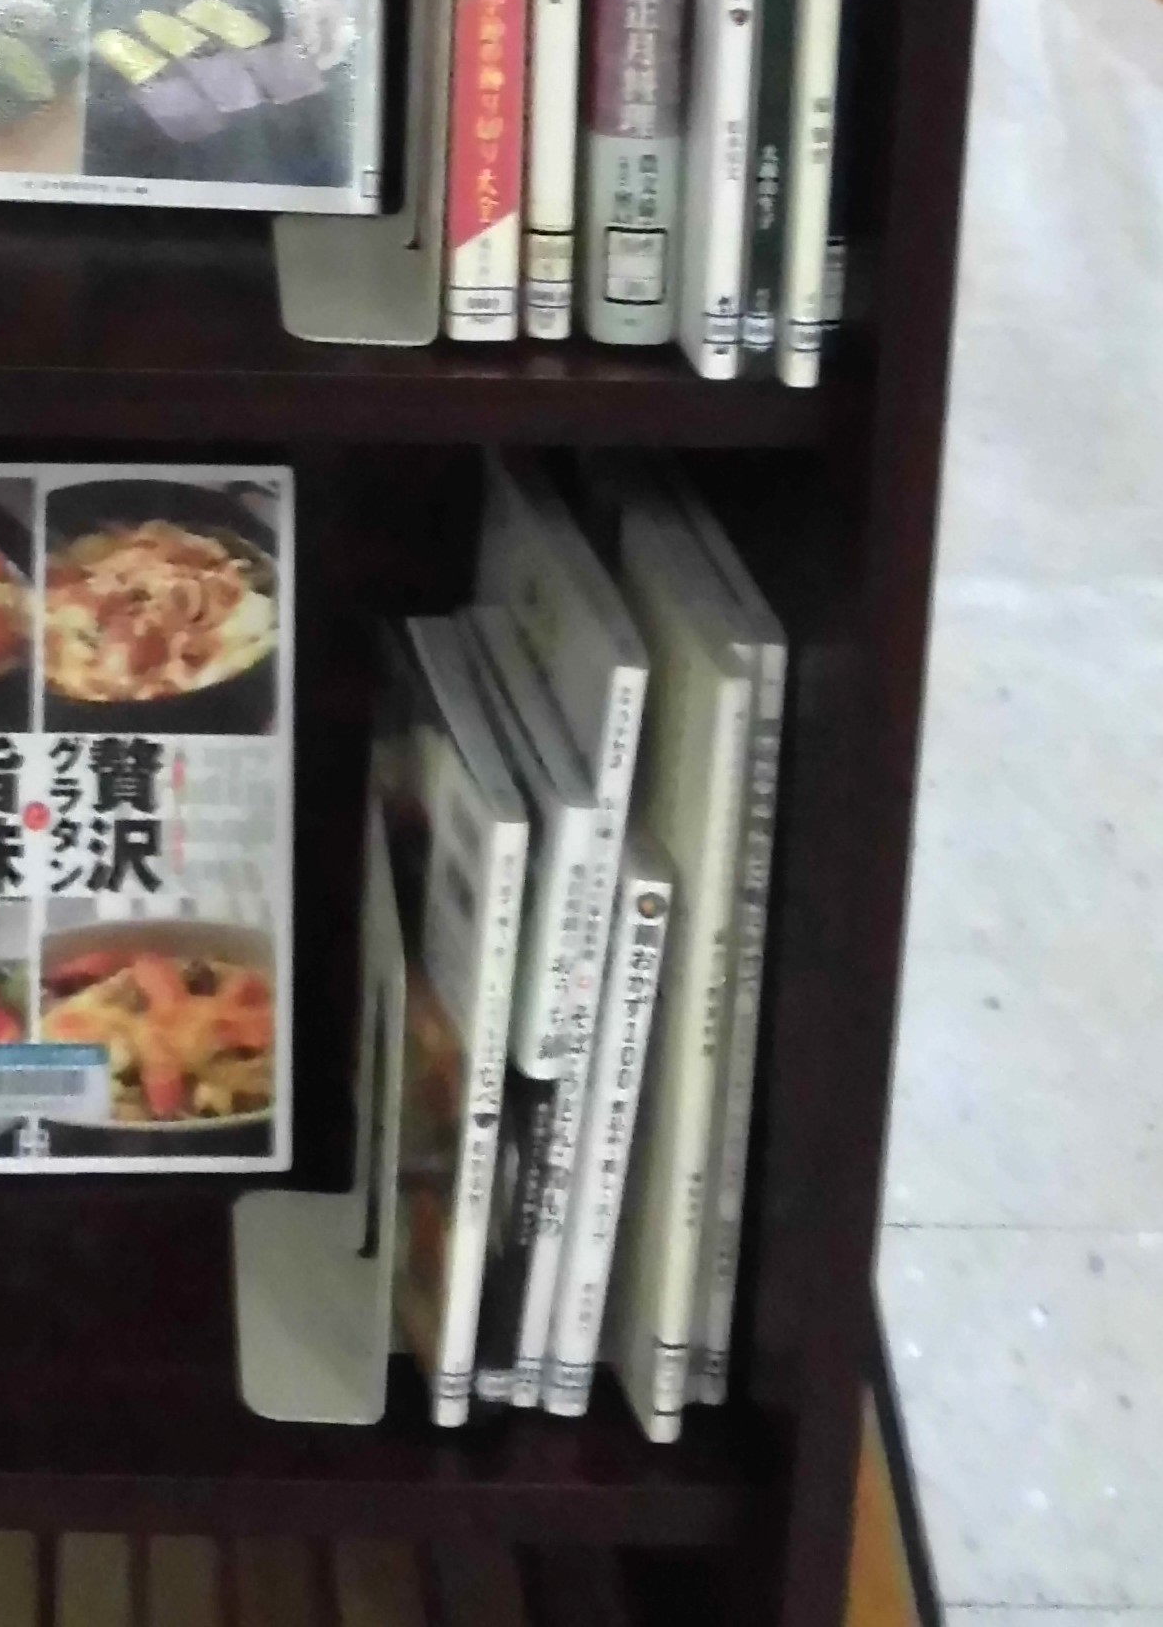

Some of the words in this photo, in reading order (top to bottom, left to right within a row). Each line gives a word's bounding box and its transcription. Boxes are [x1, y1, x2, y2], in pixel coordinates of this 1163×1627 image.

[47, 737, 85, 892] グラタン
[86, 736, 165, 893] 贅沢
